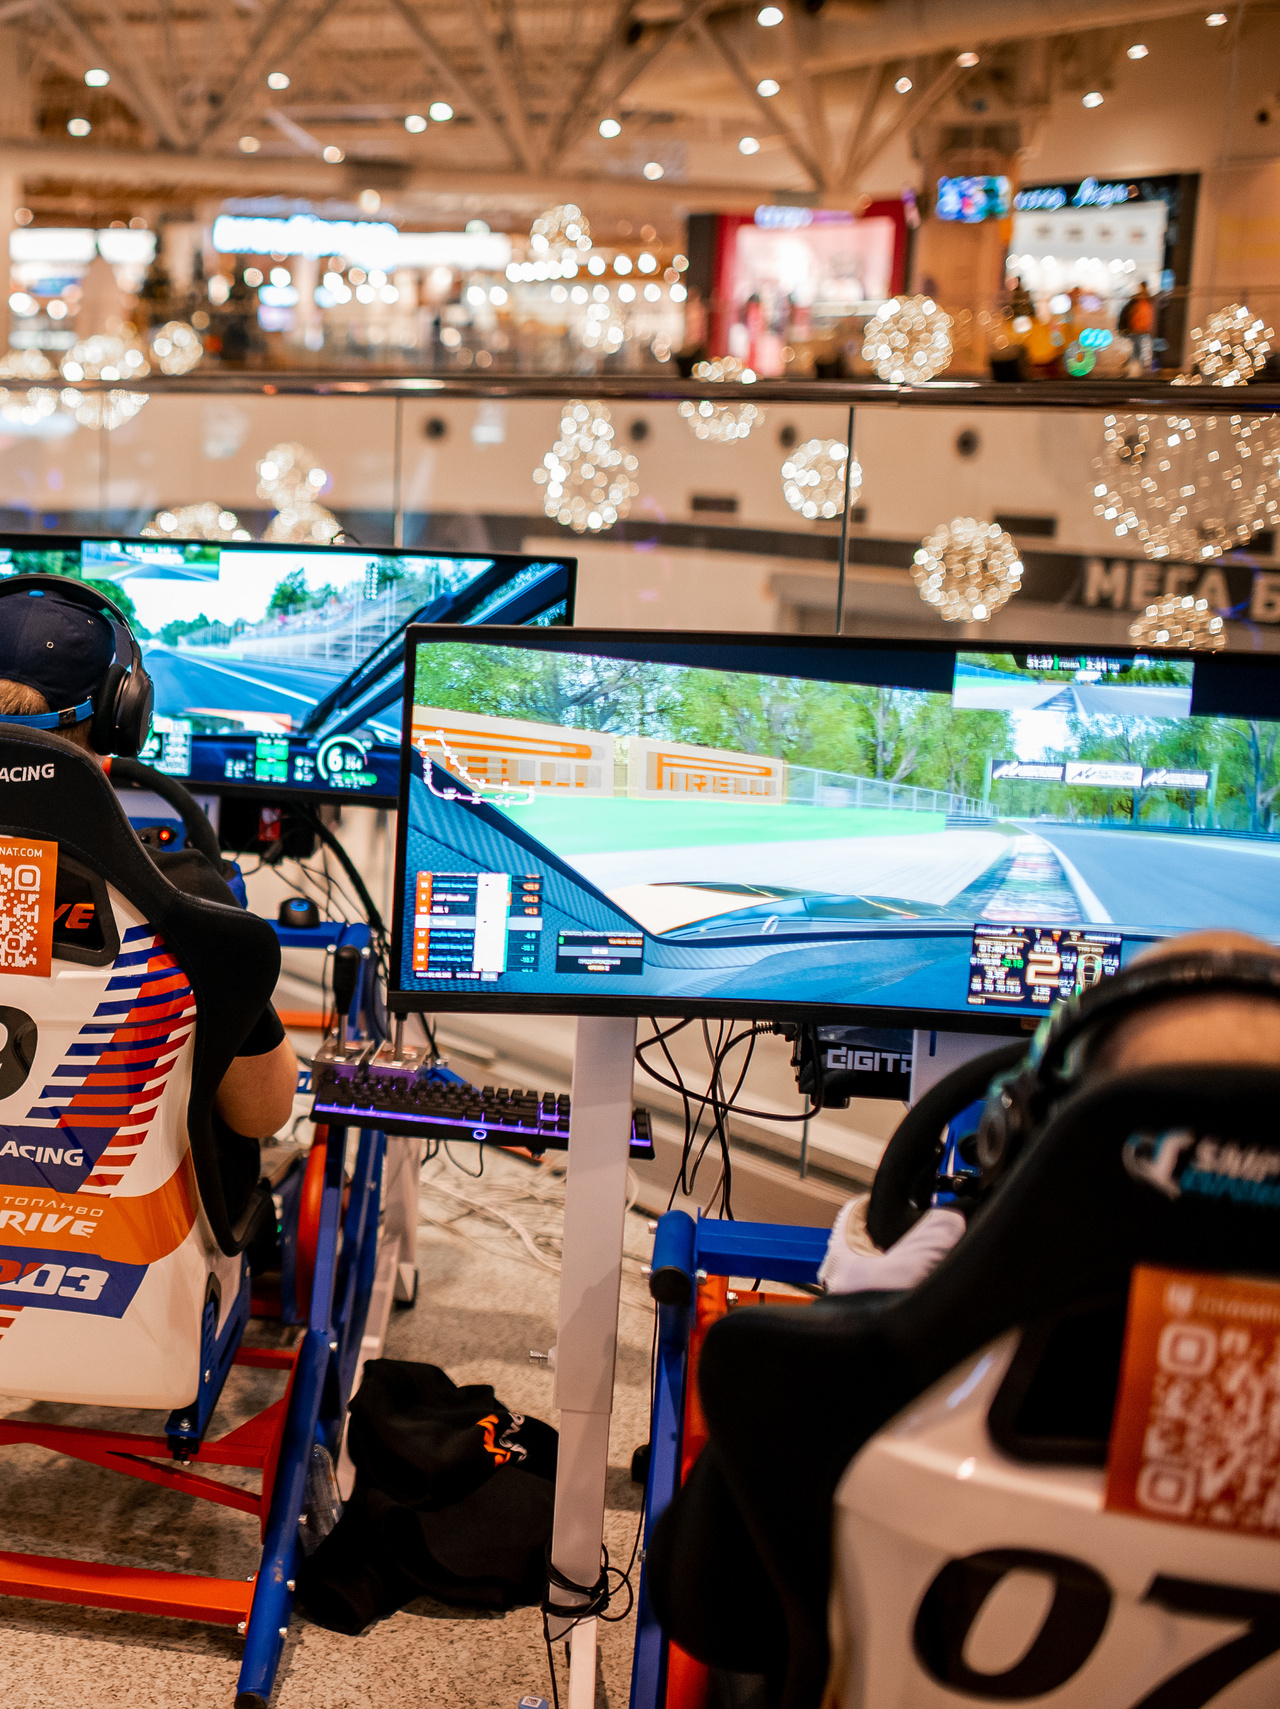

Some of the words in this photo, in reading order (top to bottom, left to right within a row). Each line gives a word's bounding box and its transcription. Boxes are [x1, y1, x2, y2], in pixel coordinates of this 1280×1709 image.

[327, 745, 343, 772] 6
[657, 752, 773, 796] PIRELLI
[1025, 950, 1062, 987] 2
[2, 1195, 104, 1218] ТОПЛИВО
[909, 1547, 1280, 1709] 07
